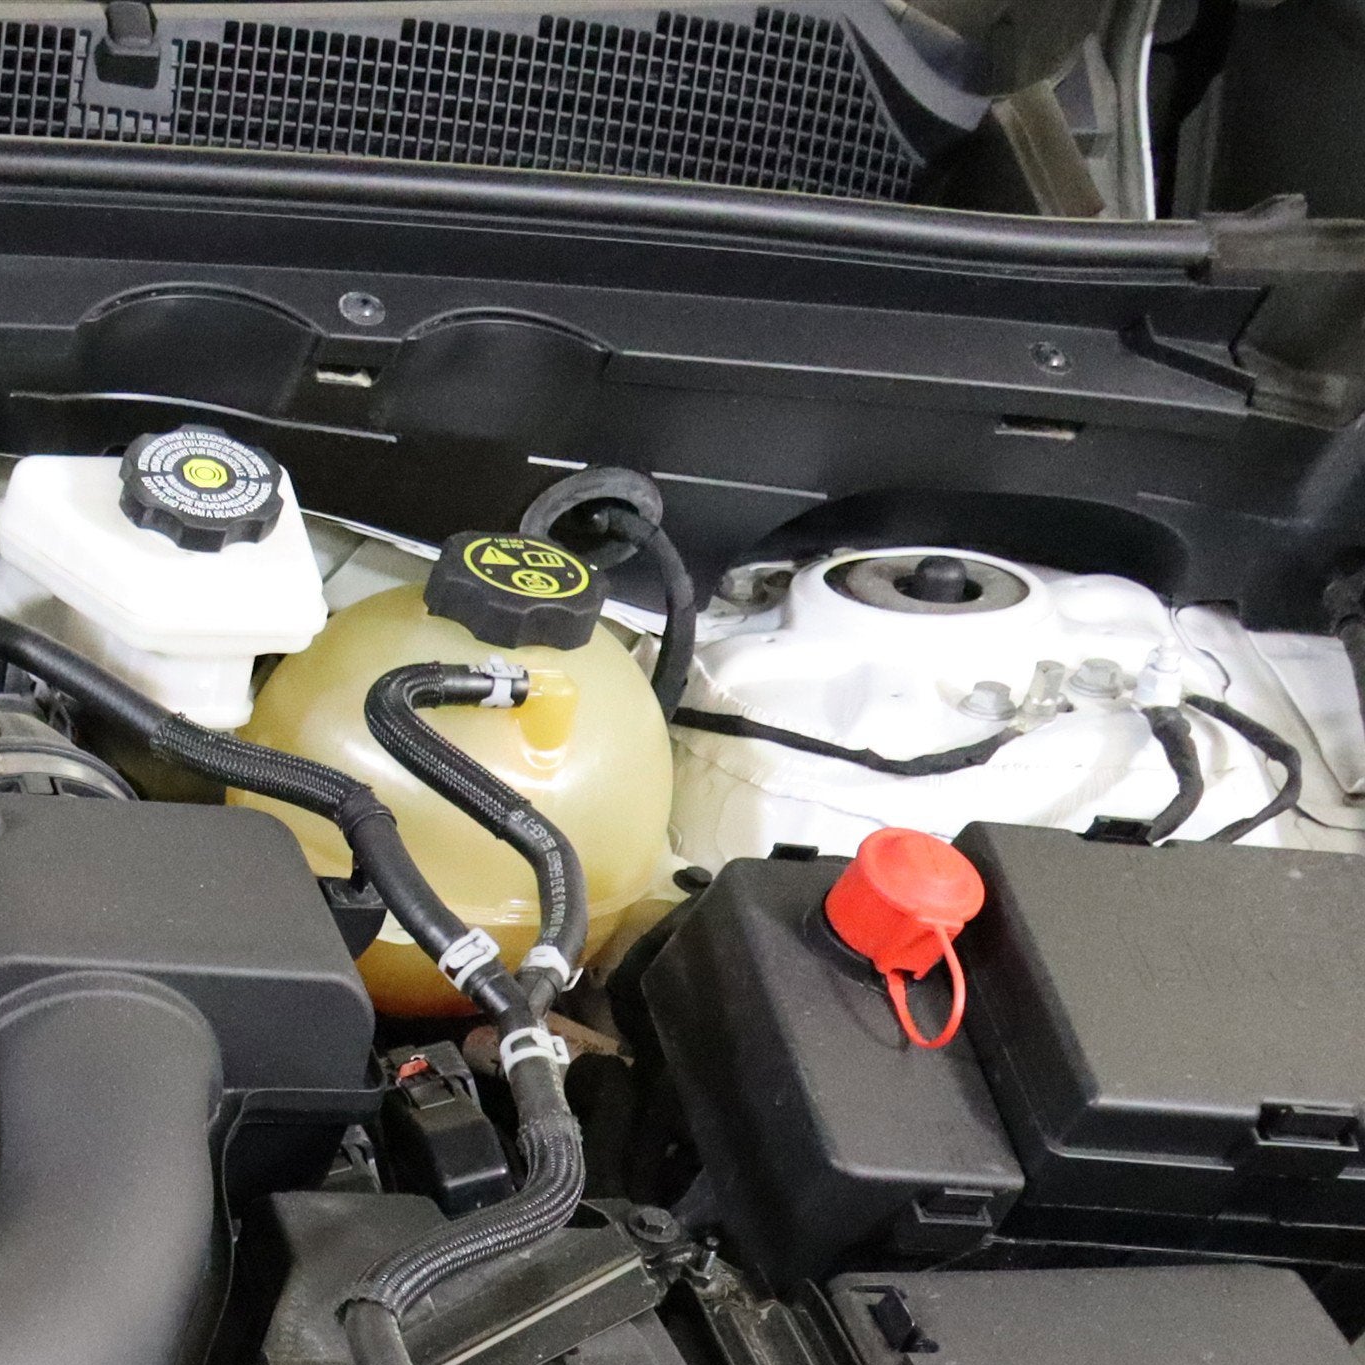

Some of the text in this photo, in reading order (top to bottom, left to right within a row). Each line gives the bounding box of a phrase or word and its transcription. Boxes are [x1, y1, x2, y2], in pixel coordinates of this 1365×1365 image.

[201, 493, 231, 502] CLEAN
[178, 503, 206, 518] FROM
[206, 509, 214, 519] A
